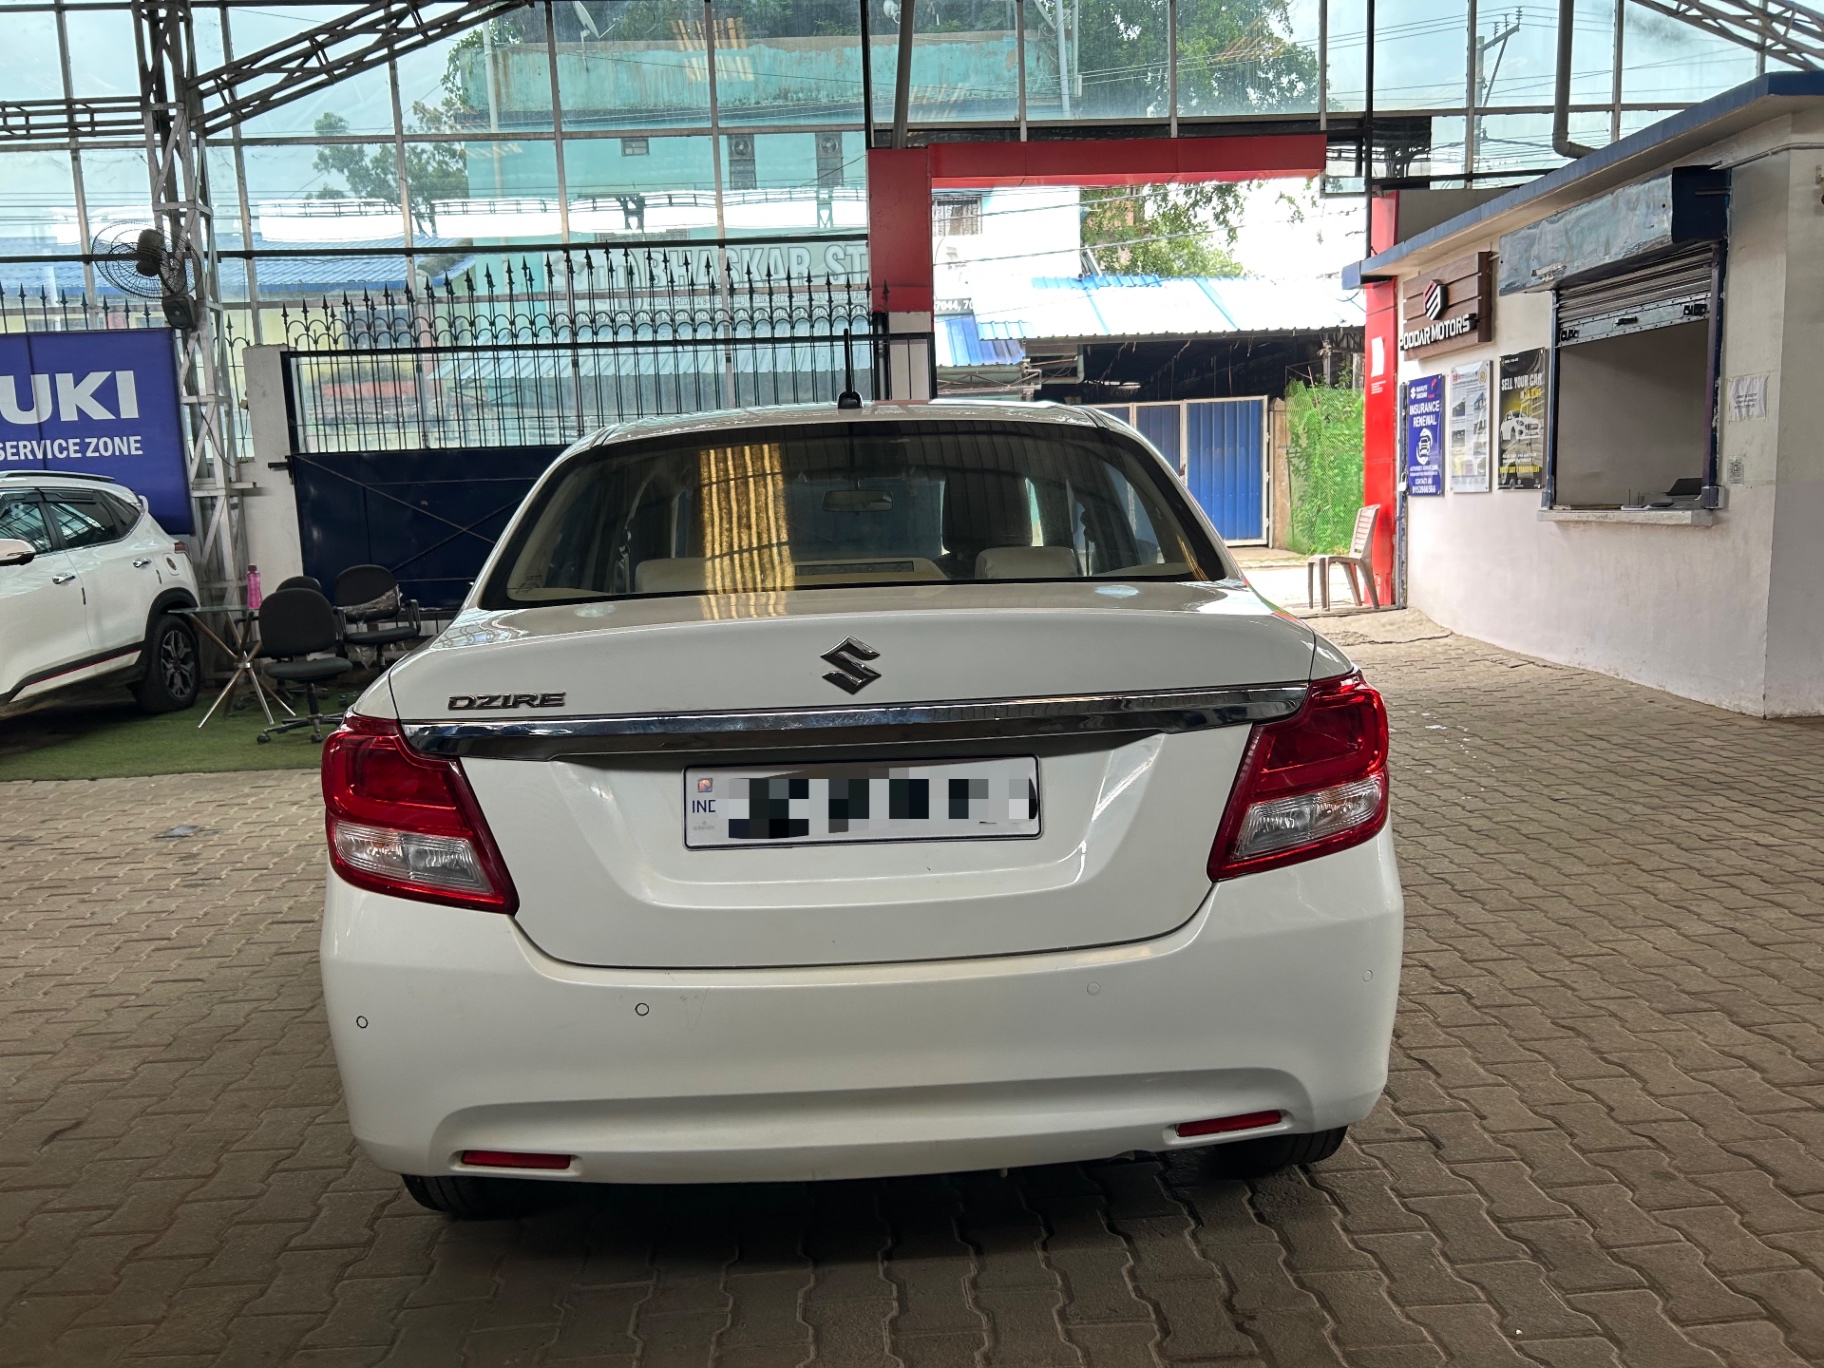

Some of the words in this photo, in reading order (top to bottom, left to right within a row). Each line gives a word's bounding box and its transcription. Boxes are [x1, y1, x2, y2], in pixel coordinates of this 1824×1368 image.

[644, 246, 812, 289] BHASKAR
[1431, 313, 1470, 341] MOTORS
[1514, 374, 1529, 389] YOUR
[1409, 400, 1440, 415] INSURANCE
[1413, 414, 1437, 428] RENEWAL
[85, 435, 143, 458] ZONE
[448, 691, 566, 711] DZIRE
